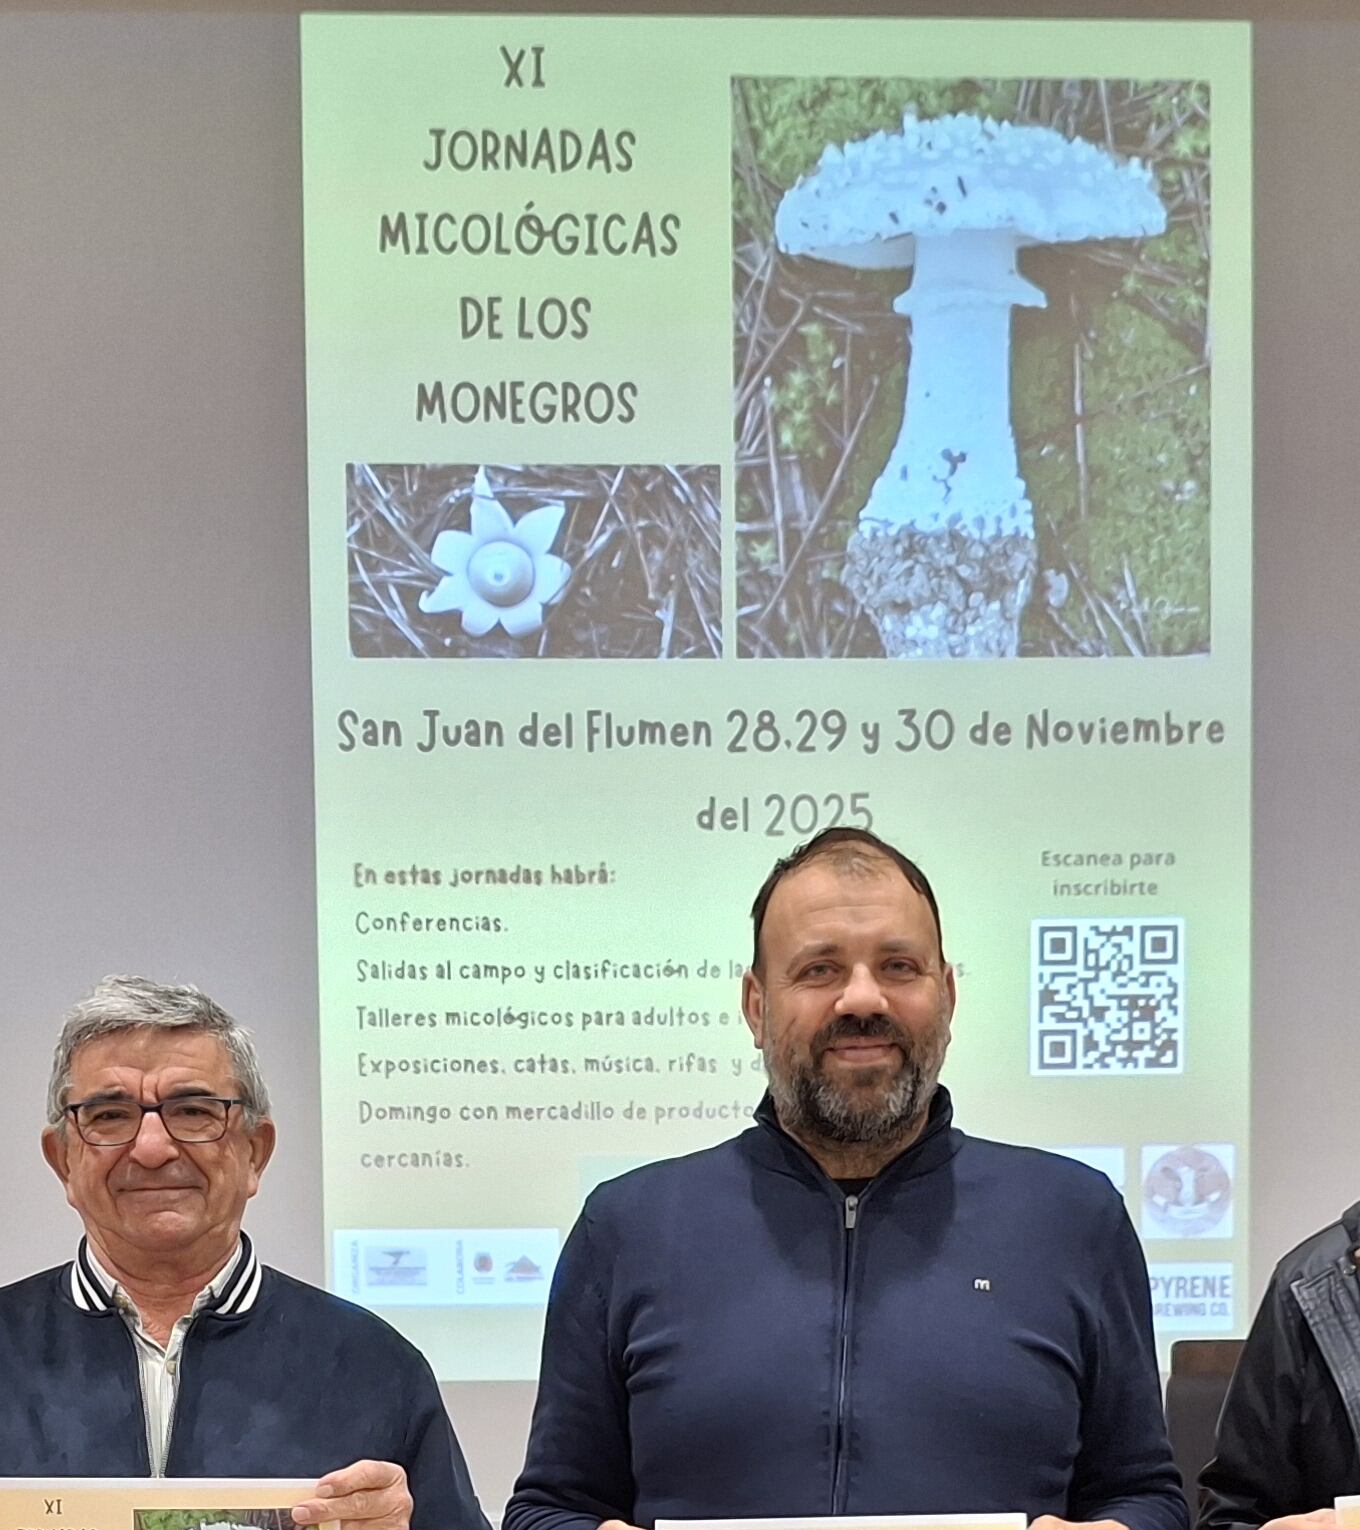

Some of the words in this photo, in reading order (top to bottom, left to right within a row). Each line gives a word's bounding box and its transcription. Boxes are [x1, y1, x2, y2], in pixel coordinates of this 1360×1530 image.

[499, 45, 545, 88] XI
[422, 127, 636, 174] JORNADAS
[379, 200, 681, 258] MICOLÓGICAS
[460, 295, 503, 339] DE
[517, 296, 591, 340] LOS
[415, 380, 637, 424] MONEGROS
[337, 709, 402, 752] San
[416, 709, 504, 753] Juan
[518, 711, 573, 749] del
[586, 709, 711, 753] Flumen
[861, 721, 879, 754] y
[894, 707, 955, 752] 30
[969, 710, 1011, 746] de
[1026, 708, 1224, 750] Noviembre
[696, 796, 749, 832] del
[763, 793, 874, 837] 2025
[1041, 850, 1123, 867] Escanea
[1129, 852, 1176, 871] para
[353, 862, 377, 888] En
[383, 863, 441, 886] estas
[448, 864, 542, 887] jornadas
[1052, 878, 1158, 896] inscribirte
[355, 911, 508, 934] Conferencias.
[356, 958, 428, 982] Salidas
[435, 959, 451, 980] al
[459, 963, 526, 985] campo
[534, 965, 545, 984] y
[553, 958, 688, 980] clasificación
[696, 958, 720, 978] de
[728, 958, 743, 980] la
[356, 1005, 437, 1030] Talleres
[444, 1005, 573, 1029] micológicos
[581, 1010, 624, 1031] para
[631, 1005, 709, 1026] adultos
[719, 1012, 728, 1025] e
[668, 1052, 716, 1073] rifas
[731, 1058, 741, 1076] y
[358, 1100, 451, 1124] Domingo
[459, 1105, 498, 1121] con
[505, 1100, 614, 1121] mercadillo
[622, 1100, 646, 1120] de
[654, 1101, 752, 1126] producto
[360, 1149, 469, 1168] cercanías.
[1153, 1302, 1206, 1316] REWING
[43, 1498, 62, 1514] XI
